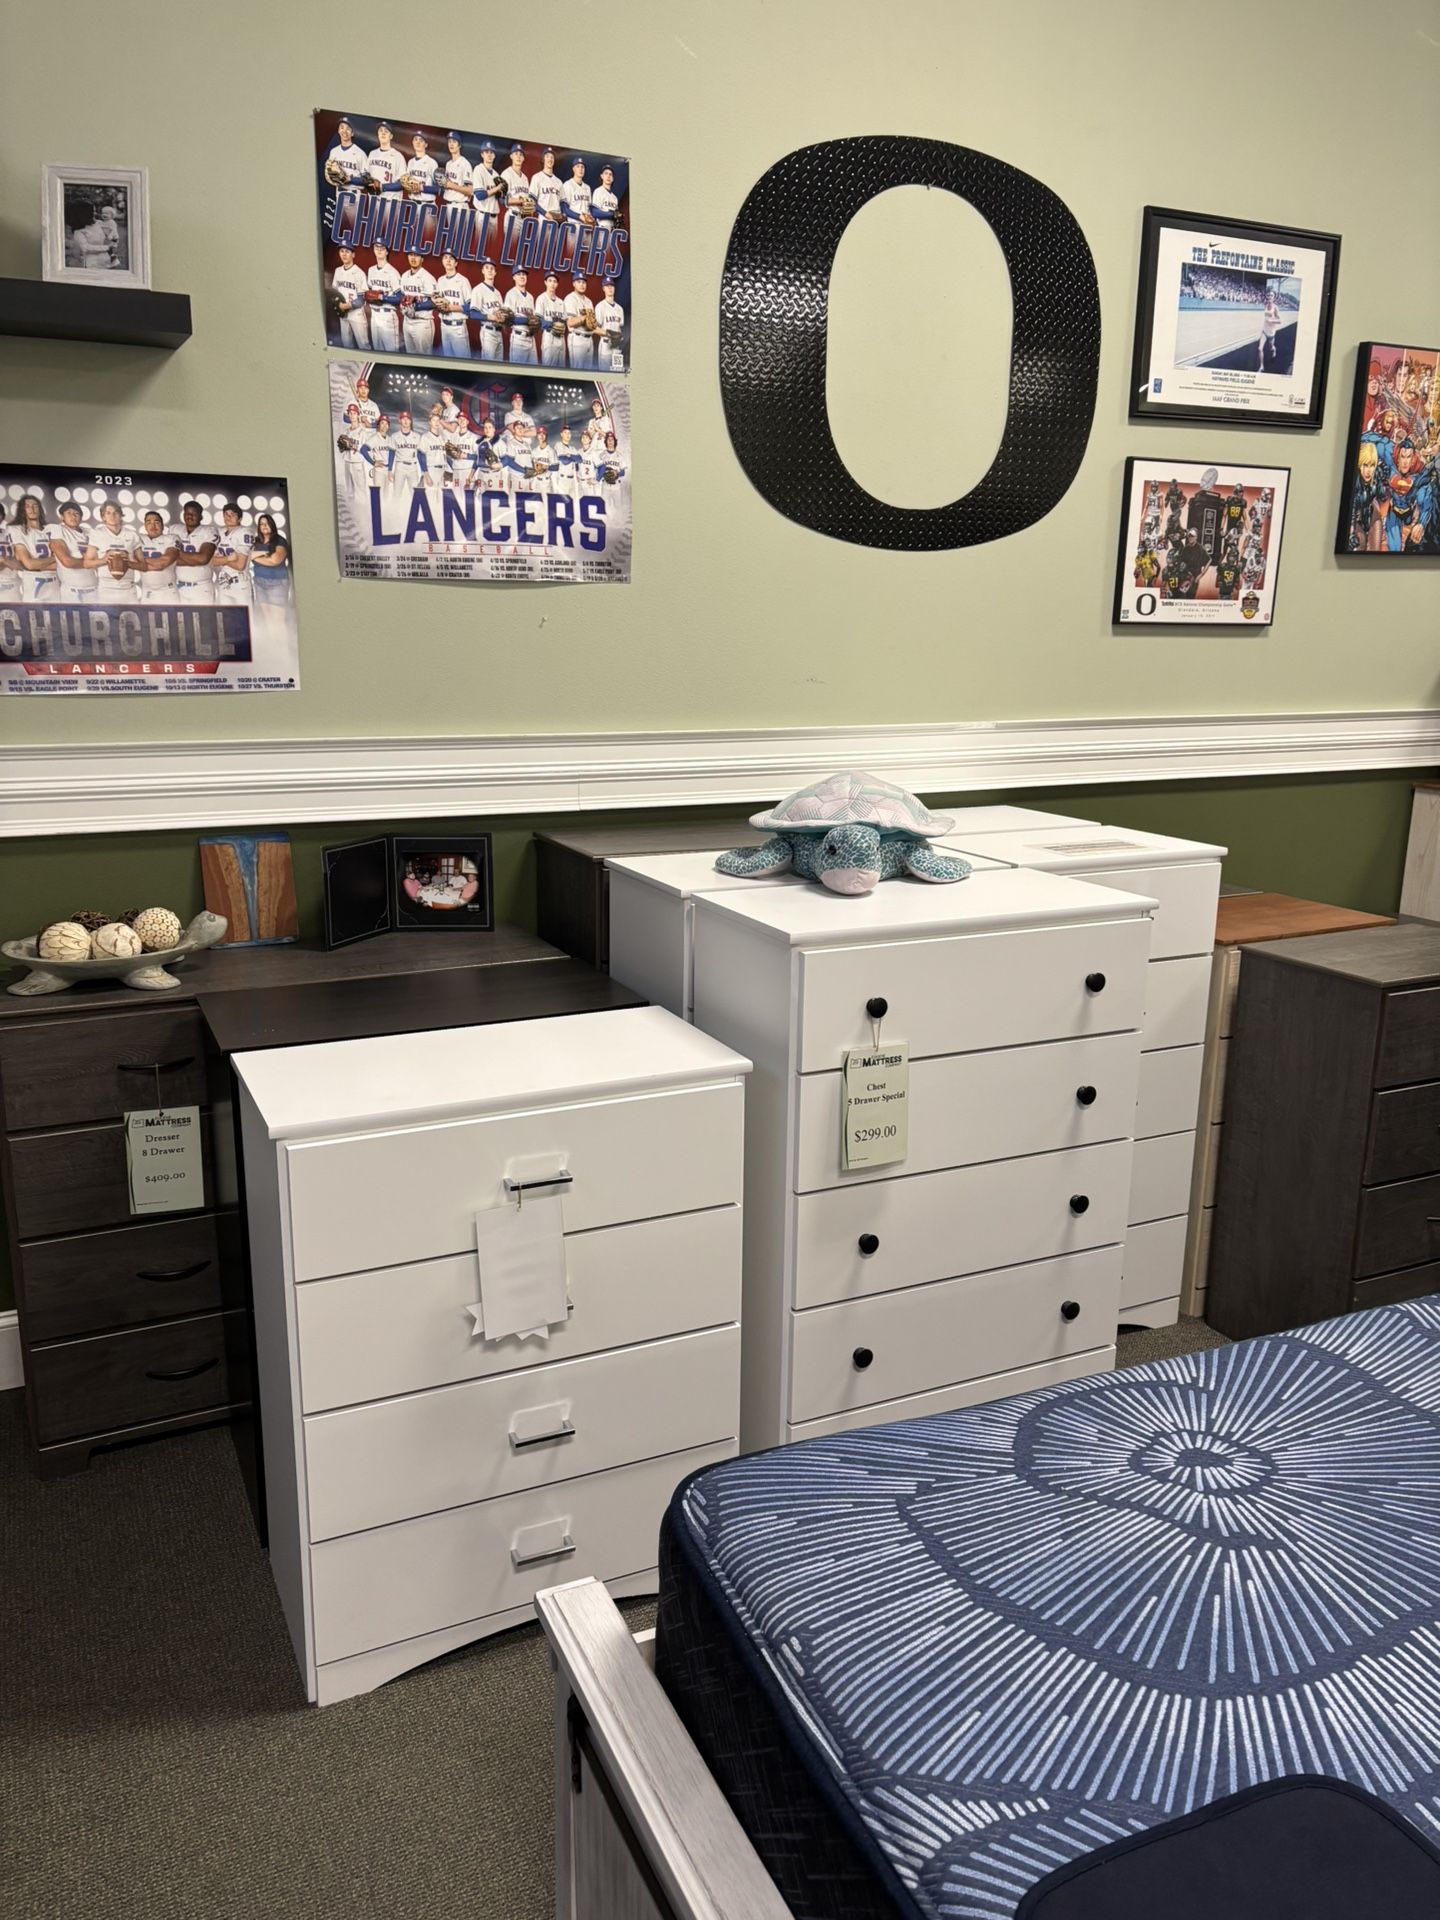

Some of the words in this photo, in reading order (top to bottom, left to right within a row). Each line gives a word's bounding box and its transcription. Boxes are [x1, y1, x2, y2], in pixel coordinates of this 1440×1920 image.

[331, 191, 491, 262] CHURCHILL
[501, 213, 629, 278] LANCERS
[1192, 246, 1208, 262] THE
[1211, 249, 1264, 270] PREFONTAINE
[1266, 257, 1295, 275] CLASSIC
[95, 475, 133, 486] 2023
[442, 479, 534, 491] CHURCHILL
[369, 487, 607, 552] LANCERS
[427, 544, 550, 556] BASEBALL
[1, 609, 236, 657] CHURCHILL
[50, 663, 195, 673] LANCERS
[866, 1082, 886, 1092] Chest
[848, 1098, 852, 1106] 5
[854, 1095, 881, 1106] Drawer
[881, 1091, 905, 1103] Special
[145, 1133, 180, 1143] Dresser
[854, 1124, 897, 1143] $299.00
[142, 1148, 148, 1157] 8
[150, 1147, 185, 1156] Drawer
[145, 1172, 186, 1184] $409.00
